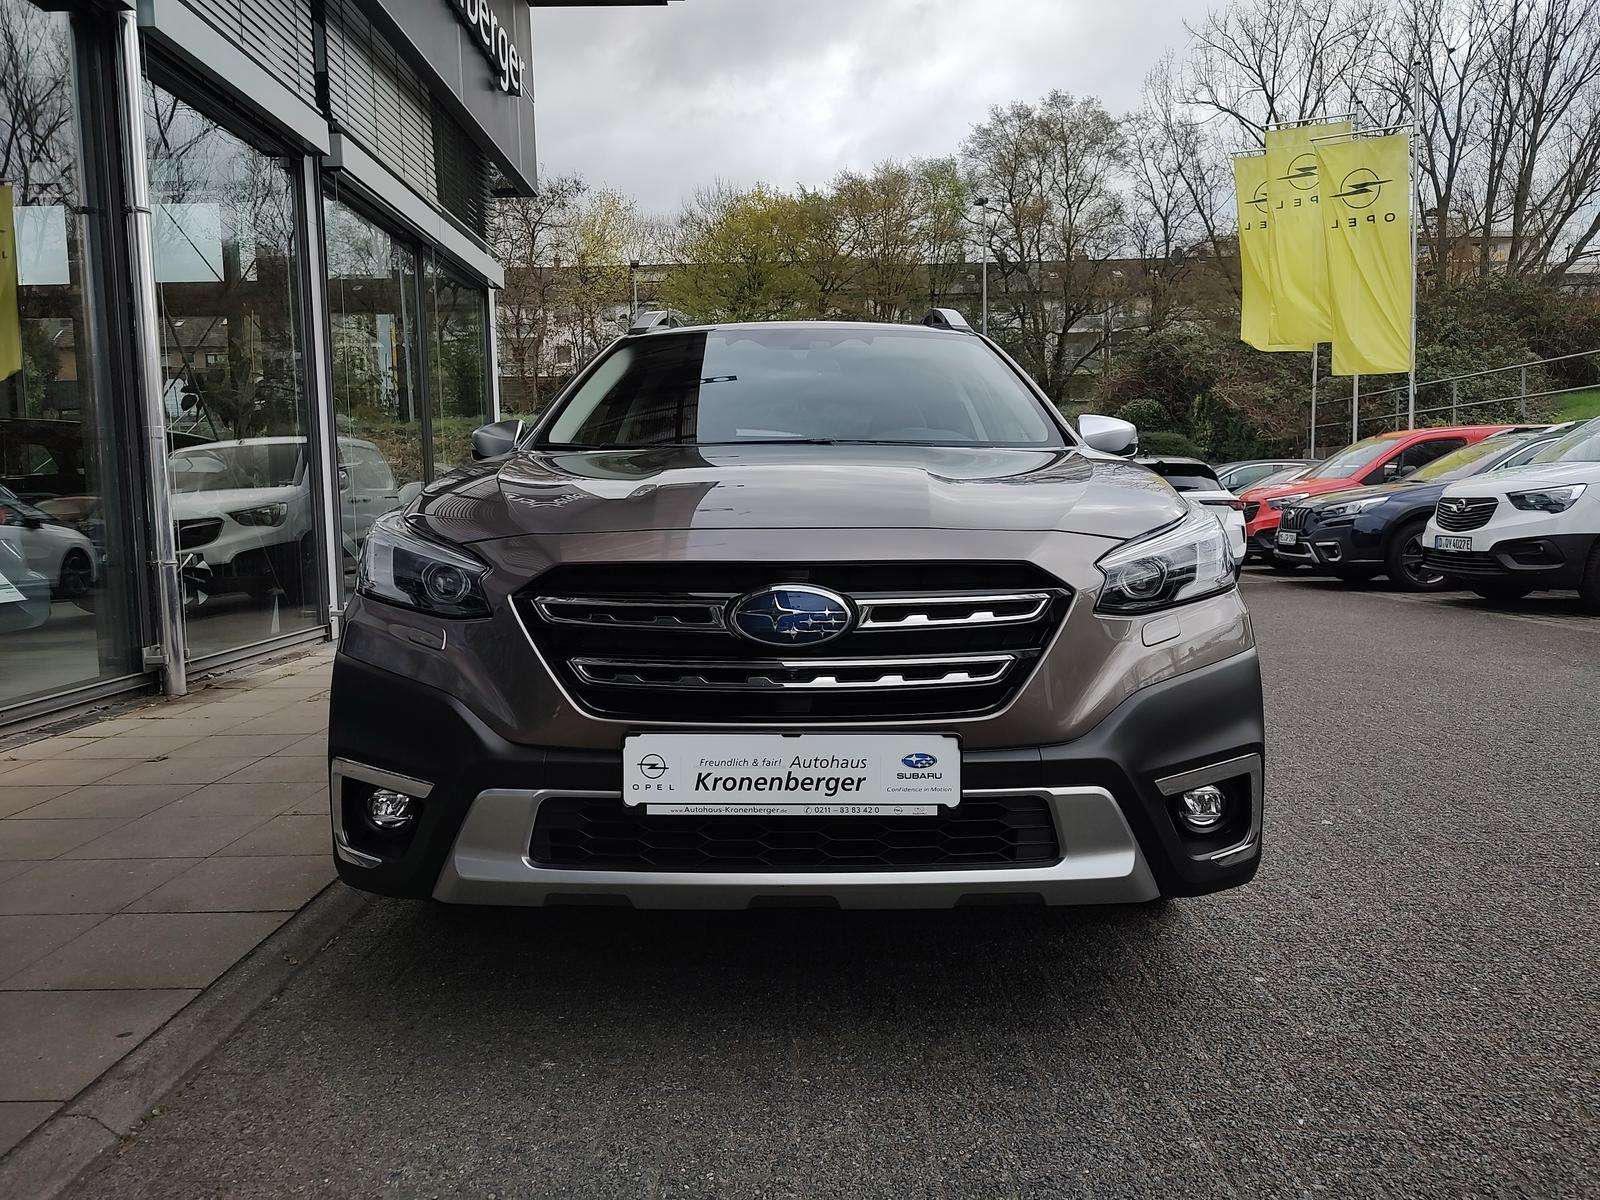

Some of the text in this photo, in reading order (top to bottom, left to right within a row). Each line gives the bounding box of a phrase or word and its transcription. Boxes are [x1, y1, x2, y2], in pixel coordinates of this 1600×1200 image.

[699, 758, 782, 767] Freundlich & fair!
[789, 755, 868, 769] Autohaus
[896, 772, 943, 780] SUBARU
[632, 783, 675, 791] OPEL
[694, 771, 867, 797] Kronenberger
[814, 806, 831, 814] 0211
[851, 806, 861, 814] 83
[862, 806, 873, 814] 42
[874, 806, 880, 814] 0
